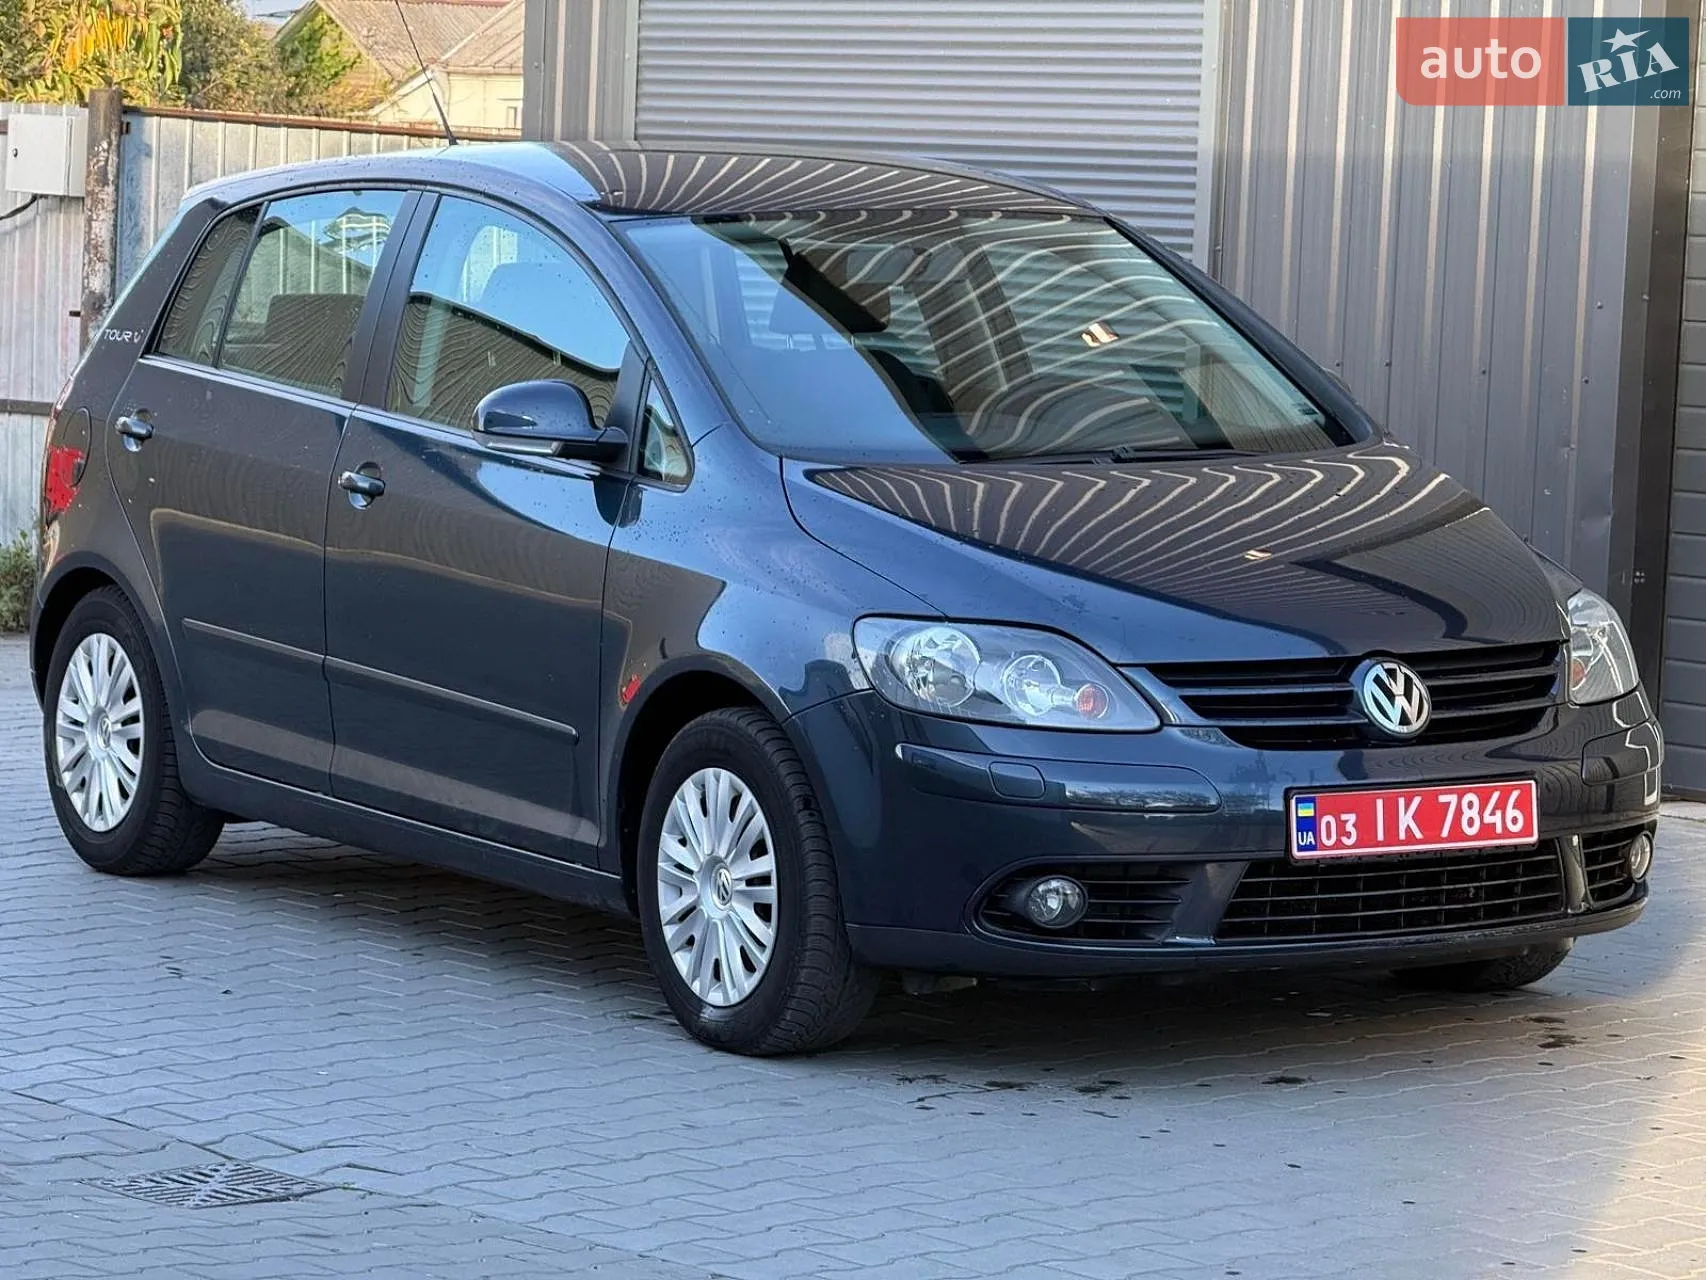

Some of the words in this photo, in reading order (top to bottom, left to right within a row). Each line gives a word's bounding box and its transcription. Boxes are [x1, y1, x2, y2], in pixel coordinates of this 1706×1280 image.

[1320, 813, 1357, 847] 03
[1376, 796, 1423, 842] IK
[1438, 789, 1524, 838] 7846
[1298, 831, 1315, 846] UA
